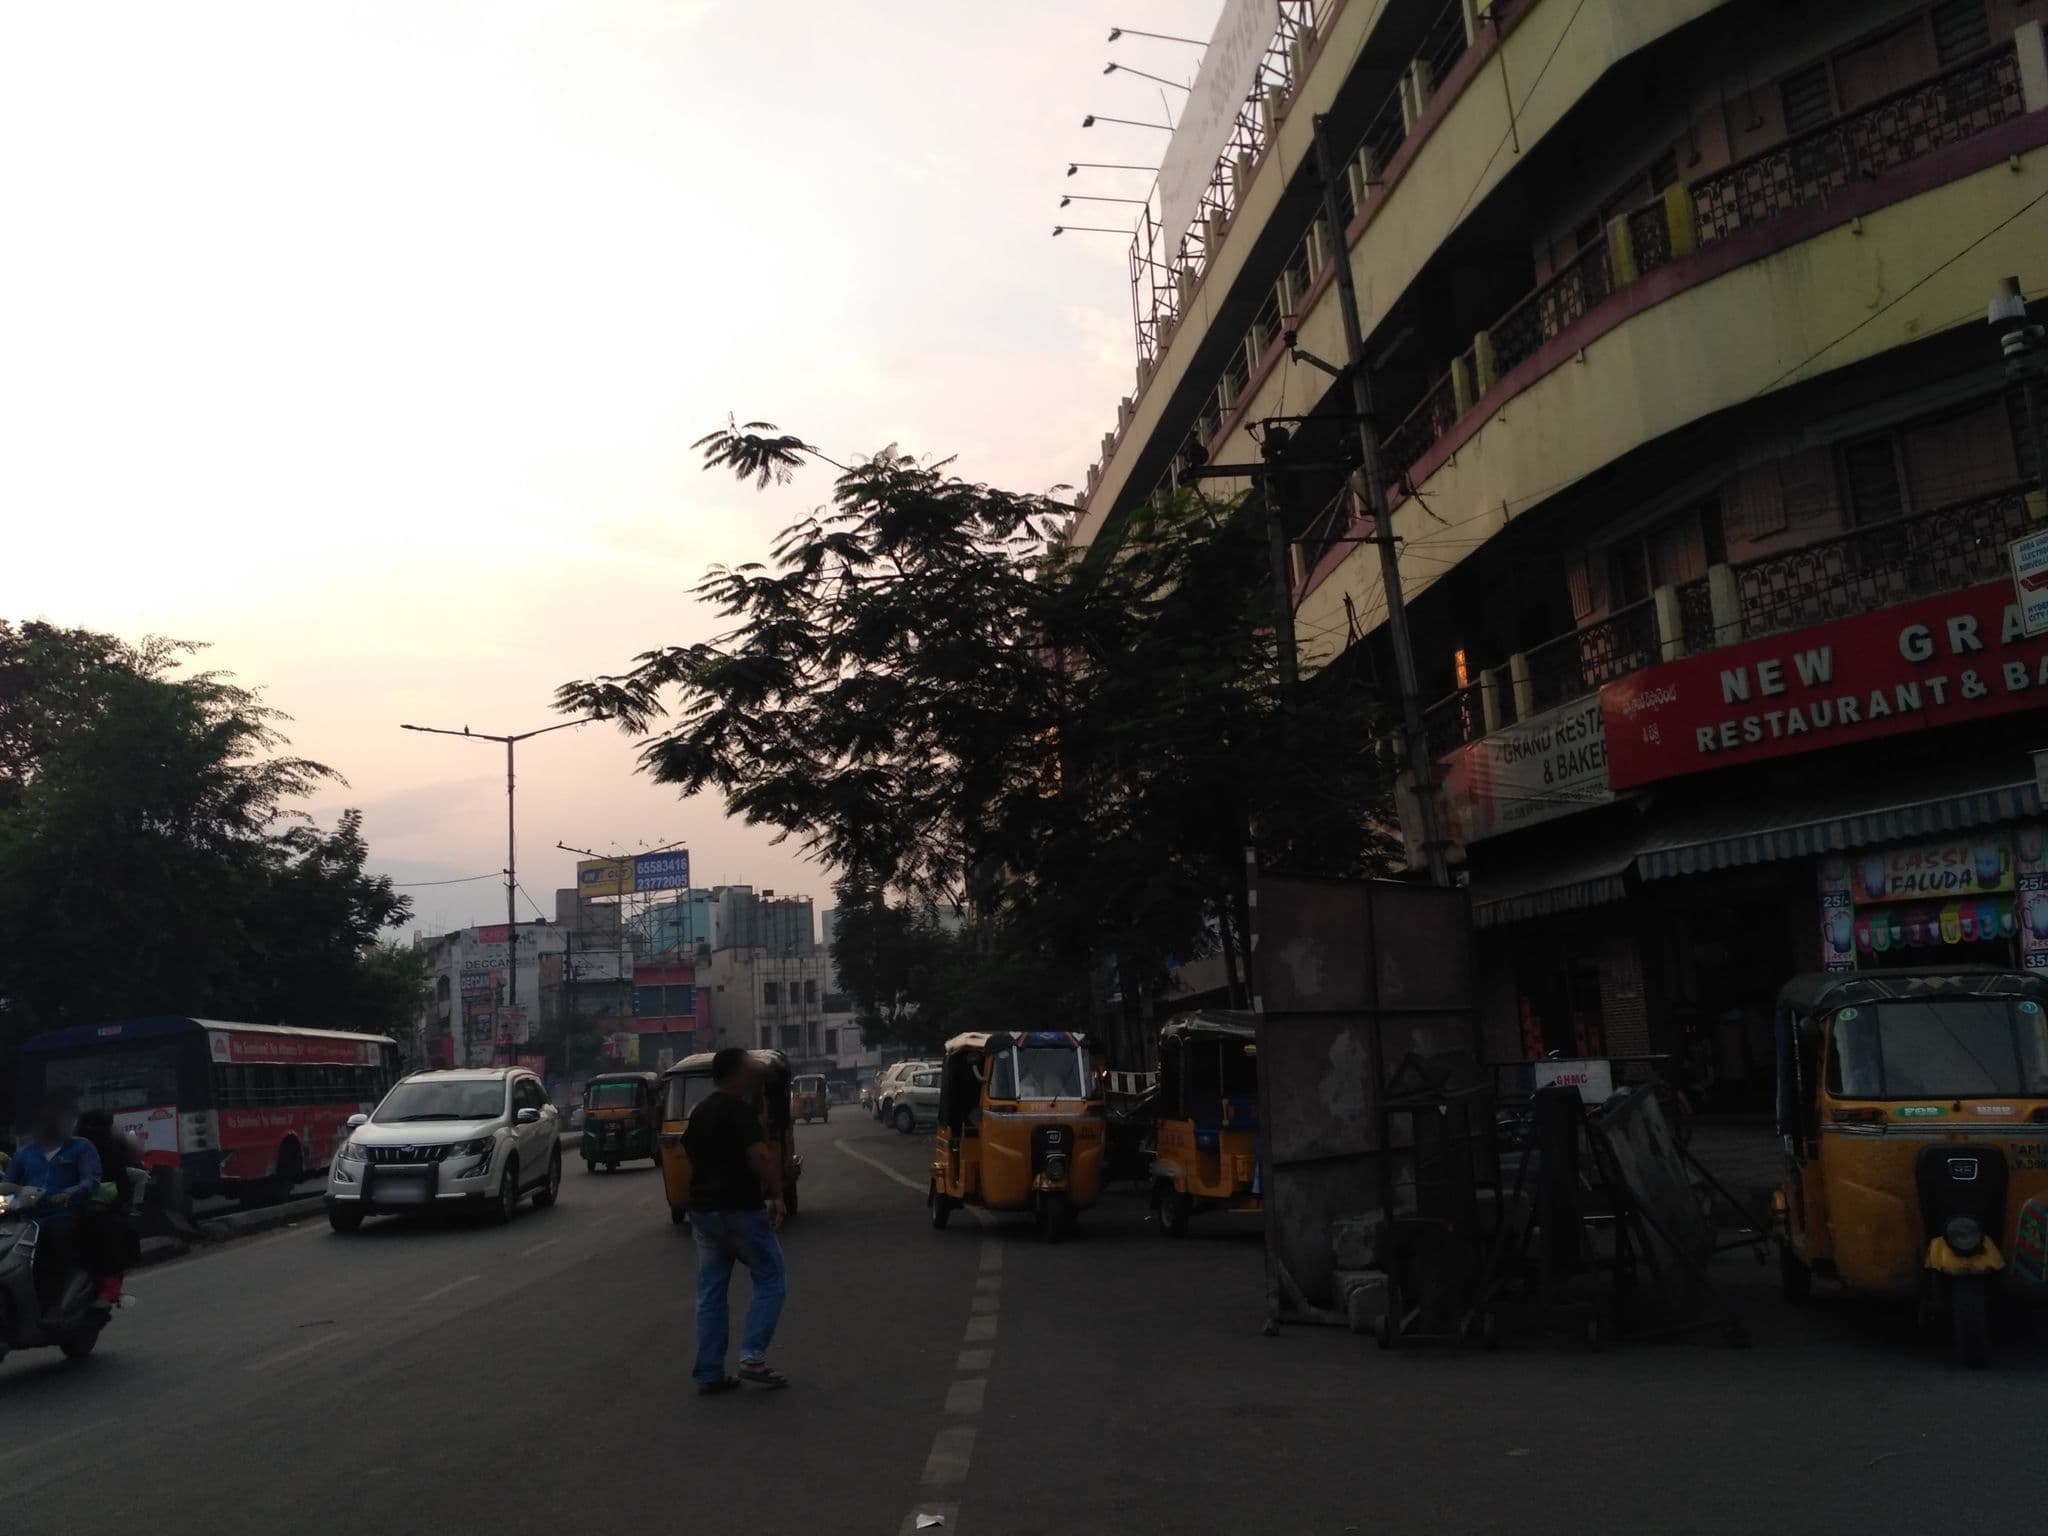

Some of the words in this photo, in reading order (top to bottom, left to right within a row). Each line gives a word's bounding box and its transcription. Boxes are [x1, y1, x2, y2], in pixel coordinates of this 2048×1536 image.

[1719, 645, 1833, 704] NEW
[1695, 675, 1949, 753] RESTAURANT
[1961, 668, 1989, 699] &
[1503, 726, 1551, 764] GRAND
[1543, 758, 1554, 785] &
[637, 858, 688, 875] 65583416
[1891, 848, 1968, 872] LASSI
[636, 874, 688, 891] 23772005
[1891, 869, 1972, 894] FALUDA
[465, 958, 514, 970] DECCAN
[1556, 1073, 1588, 1086] GHMC
